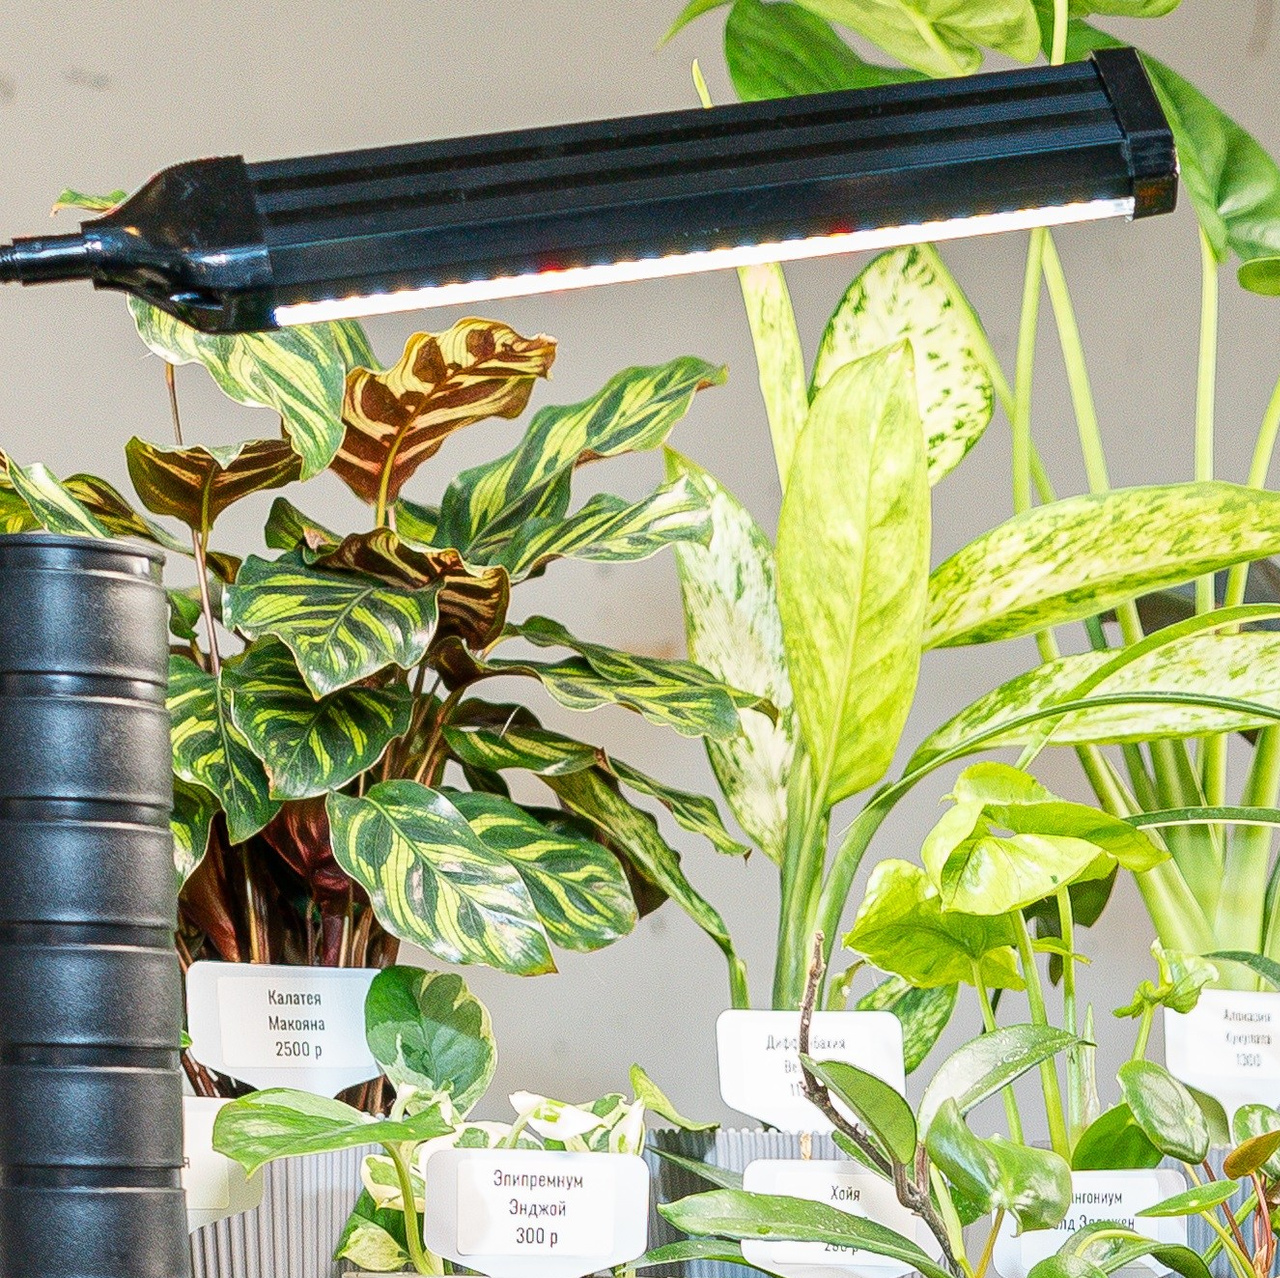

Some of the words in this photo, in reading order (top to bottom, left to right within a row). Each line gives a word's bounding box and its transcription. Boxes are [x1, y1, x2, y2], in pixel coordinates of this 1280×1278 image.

[268, 989, 321, 1006] Калатея
[268, 1016, 325, 1031] Макояна
[275, 1041, 310, 1057] 2500
[493, 1169, 584, 1190] Эпипремнум
[831, 1186, 861, 1201] Хойя
[509, 1198, 566, 1218] Энджой
[516, 1227, 545, 1244] 300
